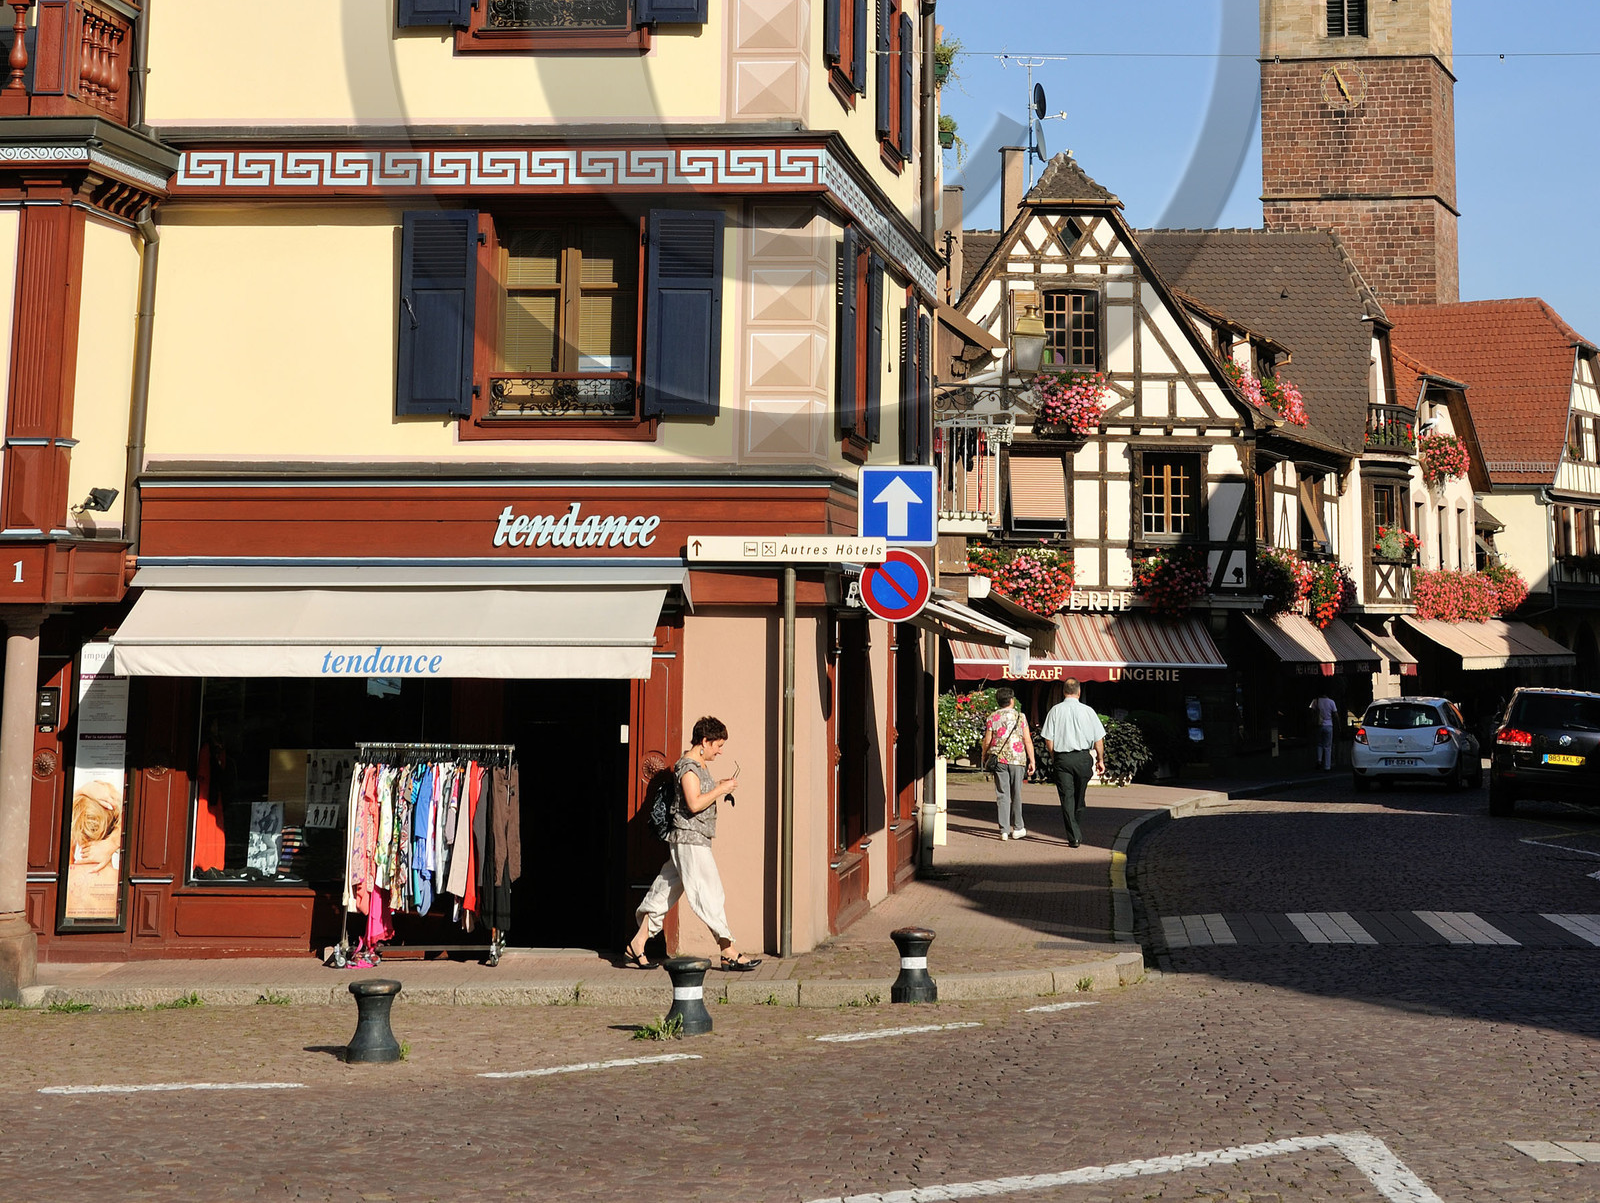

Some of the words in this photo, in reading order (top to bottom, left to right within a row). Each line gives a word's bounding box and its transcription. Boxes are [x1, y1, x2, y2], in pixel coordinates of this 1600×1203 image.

[493, 502, 661, 548] tendance
[780, 543, 828, 556] Autres
[835, 543, 882, 556] Hôtels
[12, 560, 24, 583] 1
[1058, 590, 1133, 612] ERIE
[321, 646, 443, 674] tendance
[1002, 665, 1063, 680] RGRAFF
[1108, 667, 1181, 682] LINGERIE
